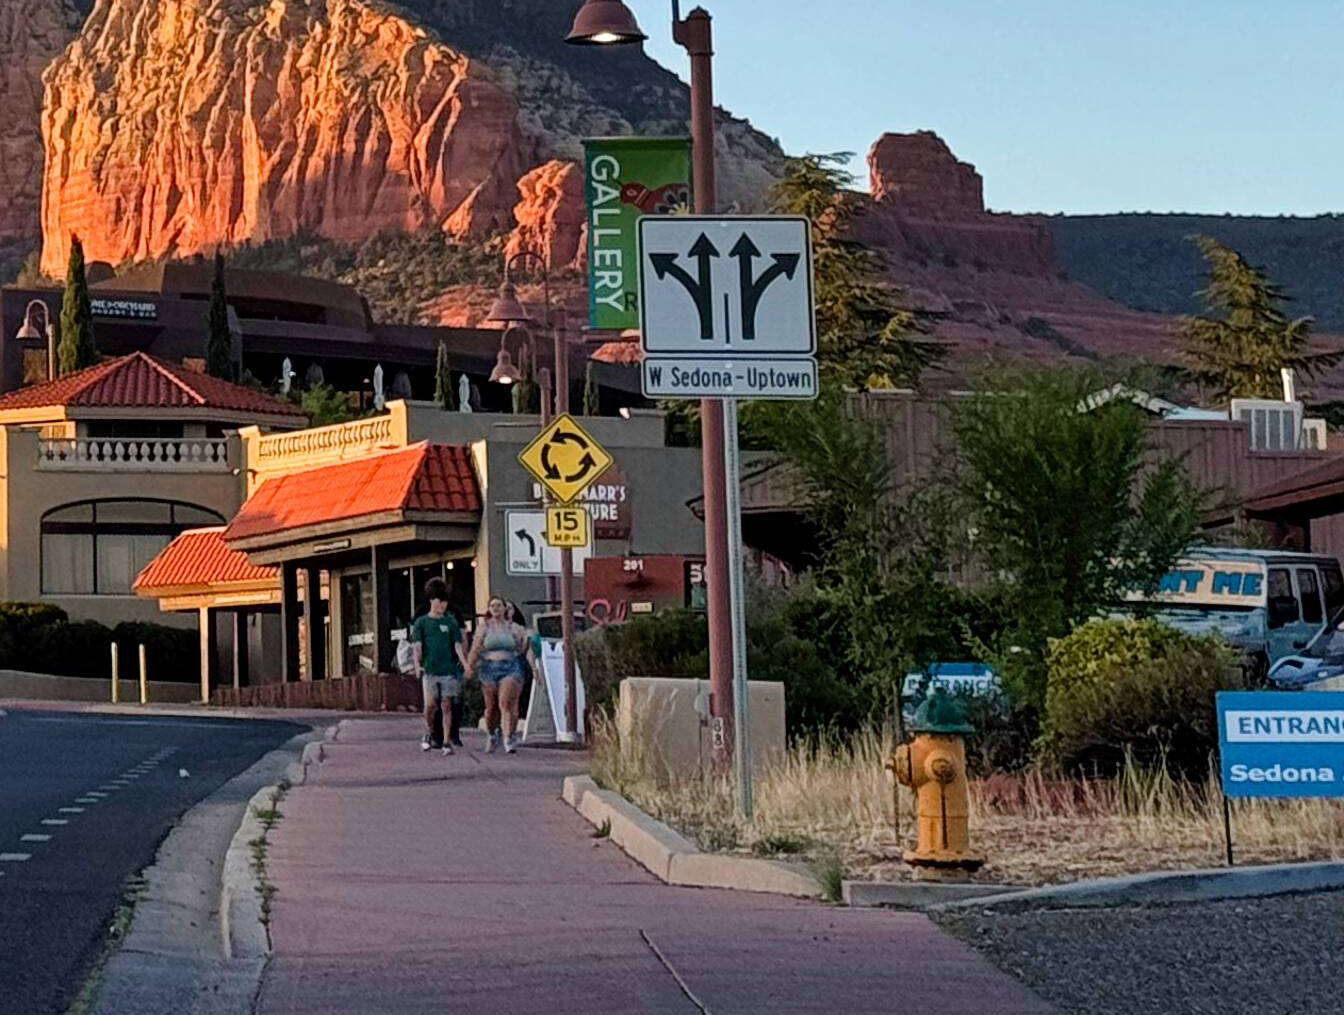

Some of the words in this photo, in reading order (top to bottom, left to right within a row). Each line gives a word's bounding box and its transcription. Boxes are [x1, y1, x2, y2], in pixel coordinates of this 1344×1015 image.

[591, 155, 624, 313] GALLERY
[648, 366, 663, 388] W
[554, 512, 579, 531] 15
[512, 561, 539, 570] ONLY
[623, 559, 644, 571] 201
[1213, 571, 1264, 596] ME
[1238, 717, 1344, 735] ENTRAN
[1230, 764, 1335, 782] Sedona
